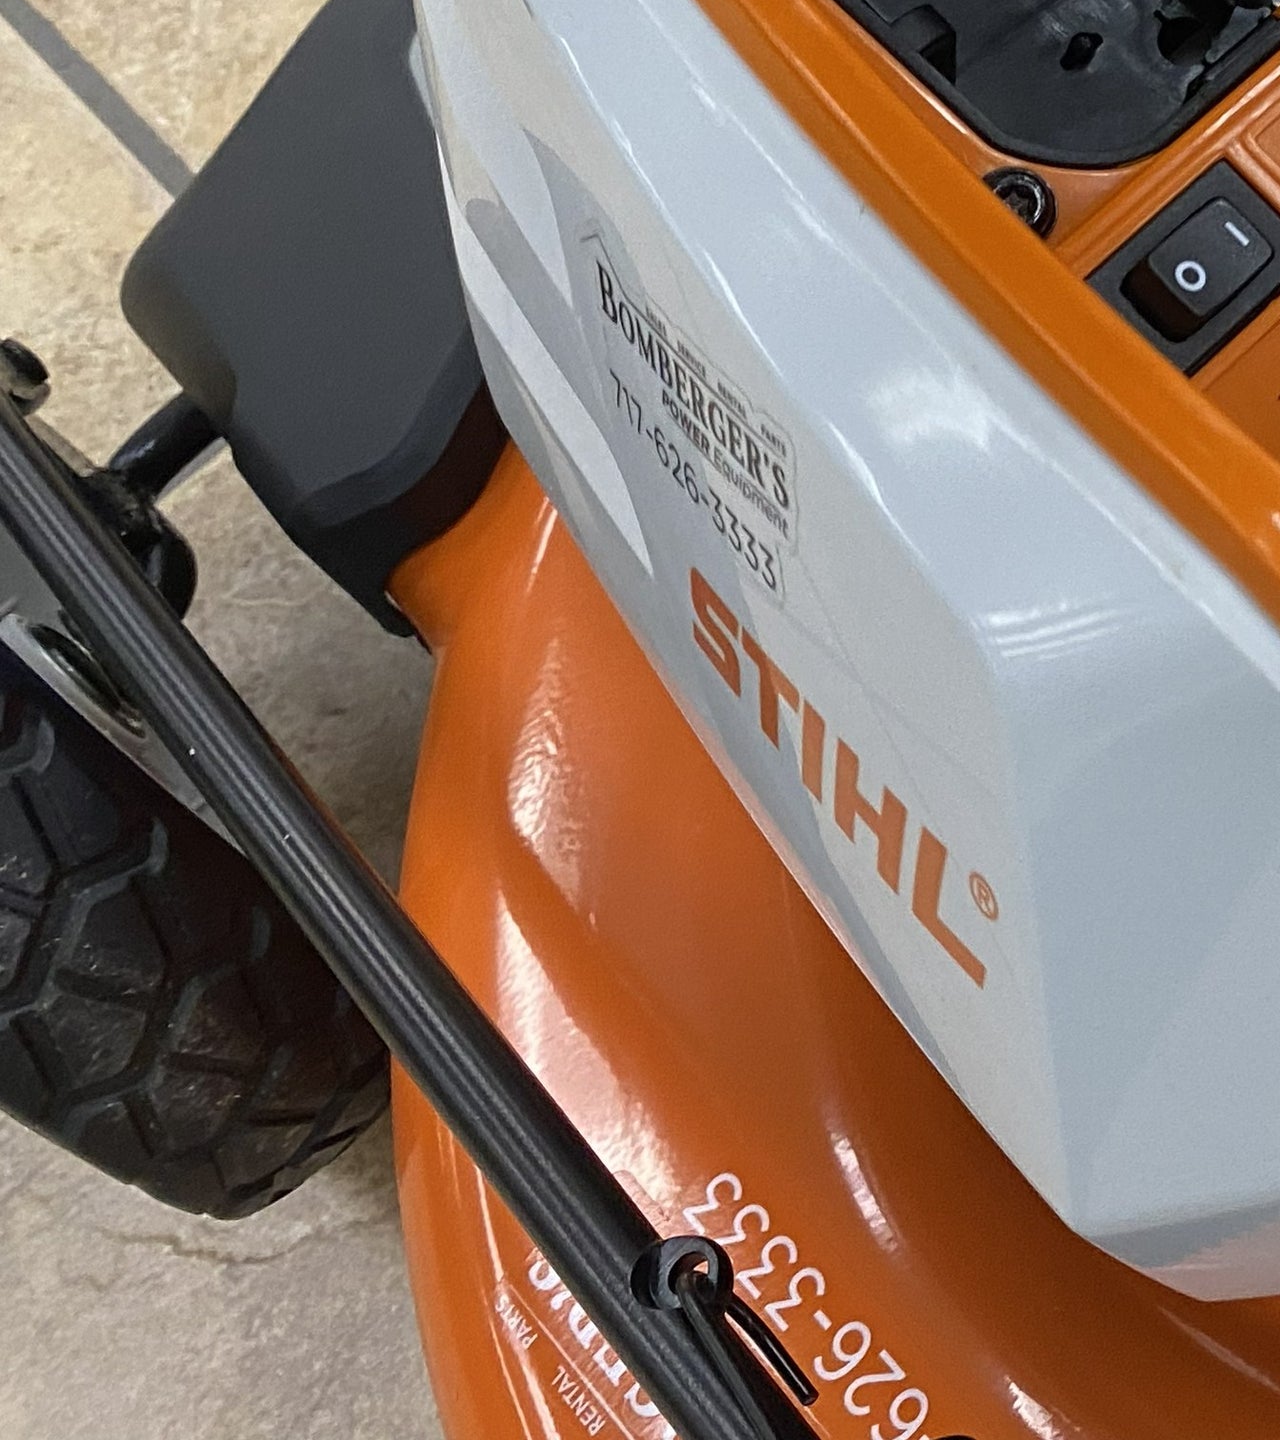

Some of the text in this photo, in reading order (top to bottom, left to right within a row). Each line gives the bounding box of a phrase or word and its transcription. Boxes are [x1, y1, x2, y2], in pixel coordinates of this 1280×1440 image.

[596, 259, 789, 509] BOMBERGER'S
[662, 389, 711, 455] POWER
[609, 368, 777, 592] 717-626-3333
[495, 1293, 606, 1437] RENTAL PARTS
